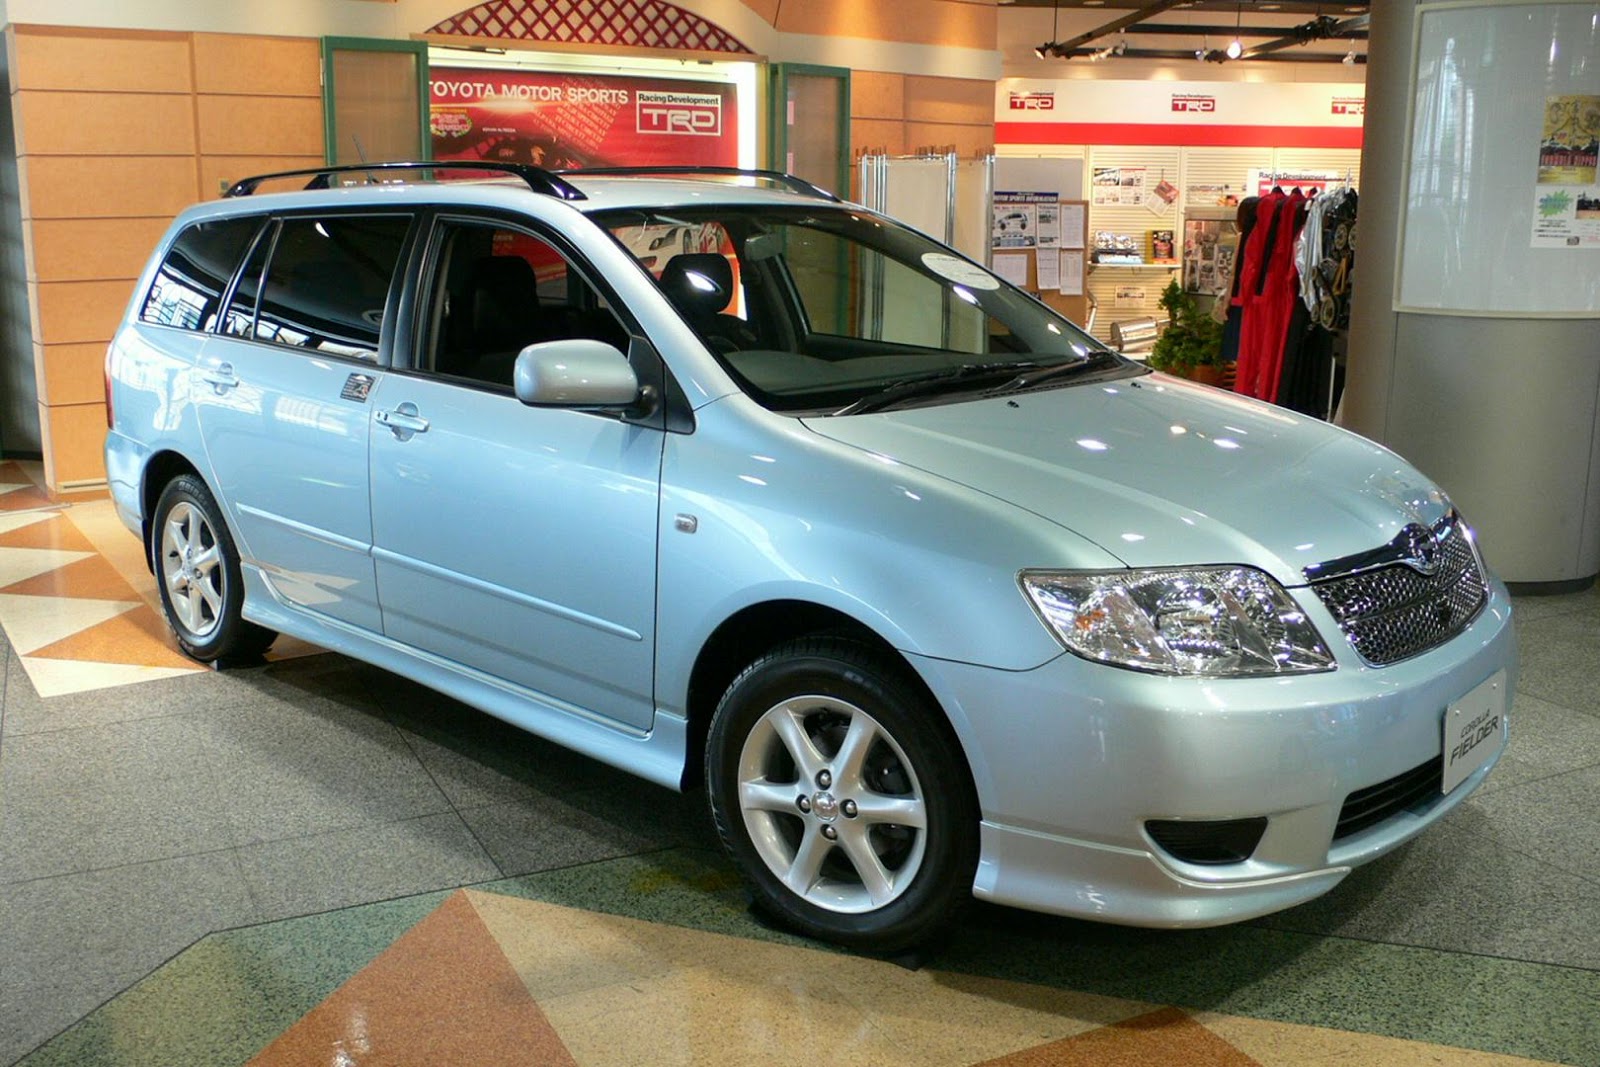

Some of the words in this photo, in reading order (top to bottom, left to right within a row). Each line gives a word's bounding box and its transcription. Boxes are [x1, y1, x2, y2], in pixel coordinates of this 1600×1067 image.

[501, 84, 561, 101] MOTOR
[567, 87, 629, 105] SPORTS
[639, 93, 666, 103] Racing
[667, 95, 719, 105] Development
[1011, 98, 1053, 110] TRD
[1172, 100, 1215, 111] TRD
[642, 108, 715, 133] TRD
[1259, 172, 1282, 180] Racng
[1450, 715, 1498, 767] FIELDER
